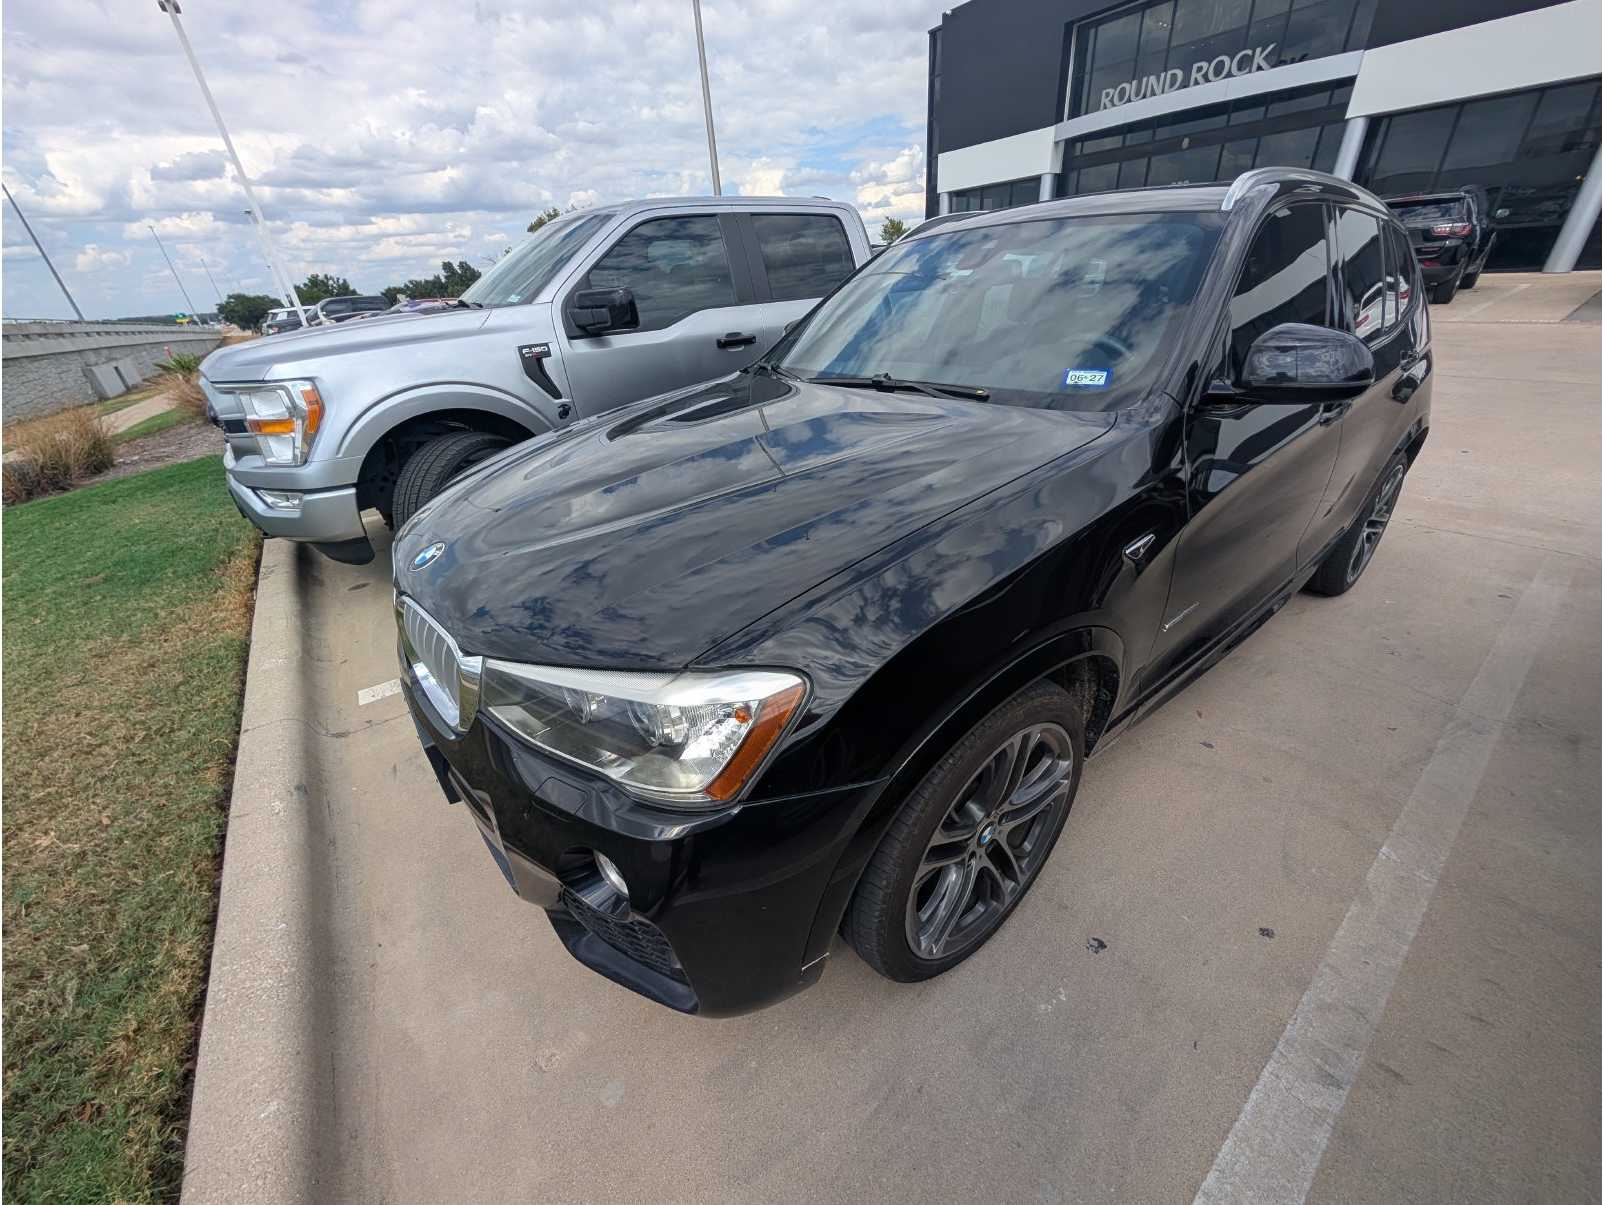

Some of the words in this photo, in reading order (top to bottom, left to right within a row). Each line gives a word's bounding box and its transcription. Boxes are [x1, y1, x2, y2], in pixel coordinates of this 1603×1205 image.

[1099, 68, 1184, 111] ROUND
[1188, 43, 1277, 87] ROCK
[522, 346, 548, 354] F-150
